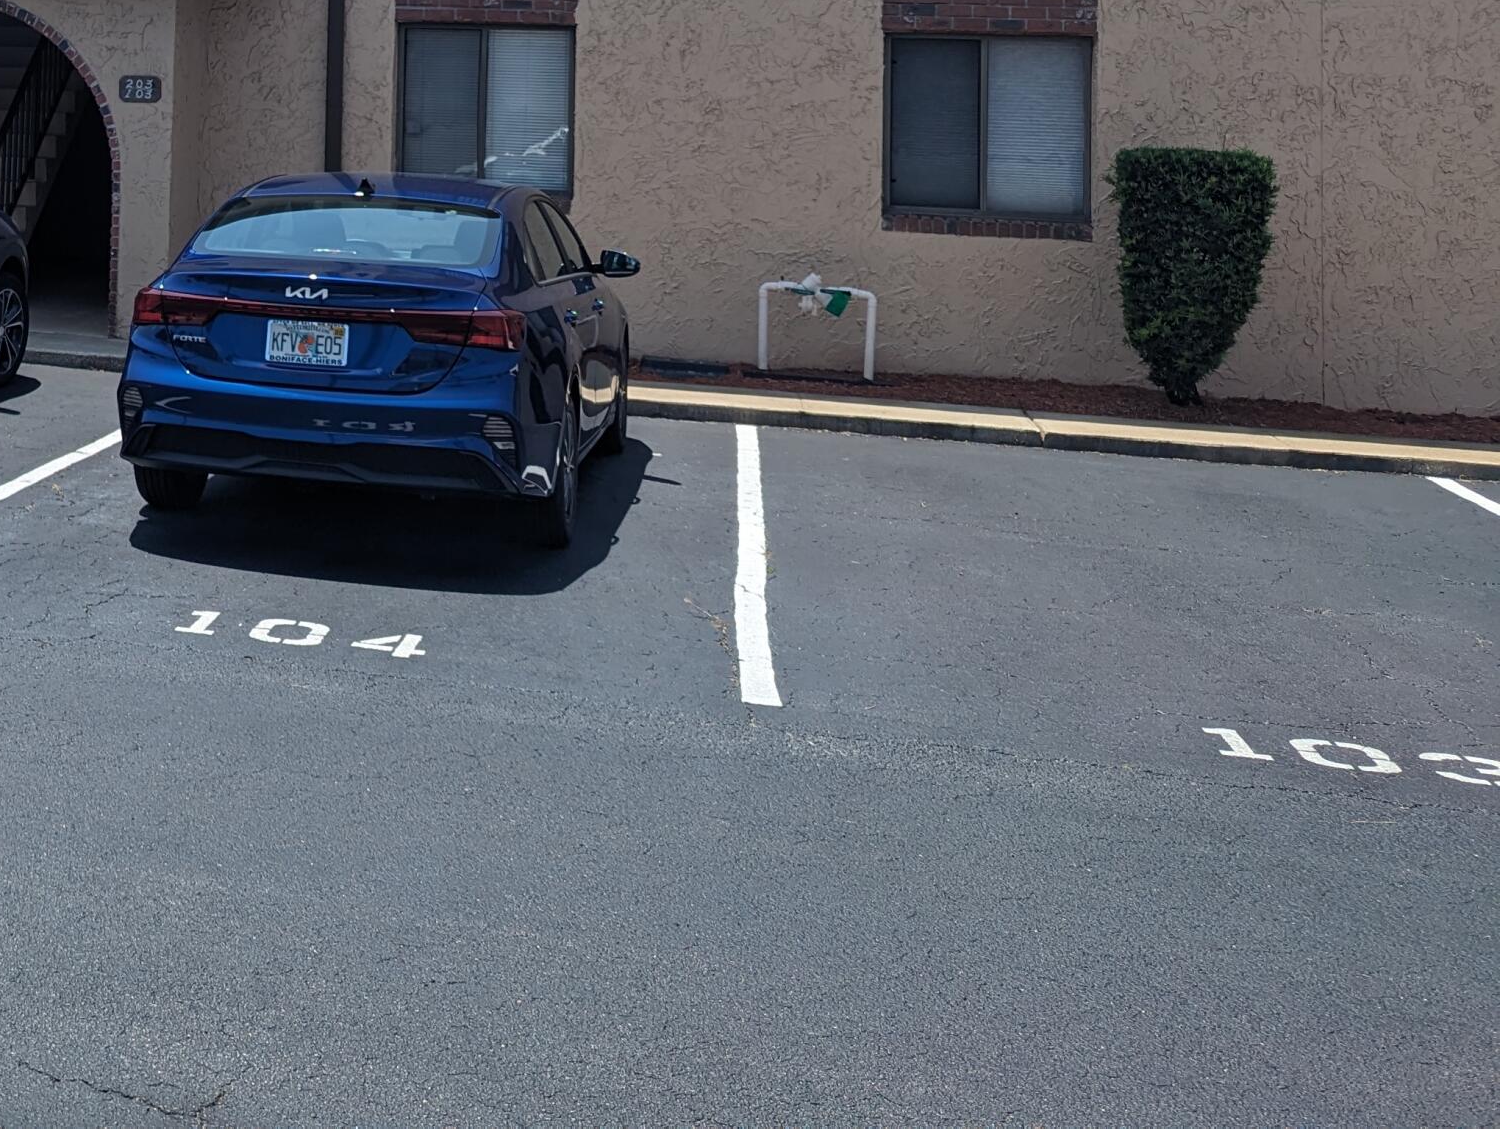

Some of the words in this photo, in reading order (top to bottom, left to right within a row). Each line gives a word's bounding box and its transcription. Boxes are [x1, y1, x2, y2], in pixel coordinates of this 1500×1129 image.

[125, 78, 154, 89] 203
[124, 89, 153, 99] 103
[284, 286, 329, 300] KIA
[172, 334, 207, 343] FORTE
[271, 331, 299, 353] KFV
[174, 610, 426, 658] 104
[1201, 726, 1500, 786] 103
